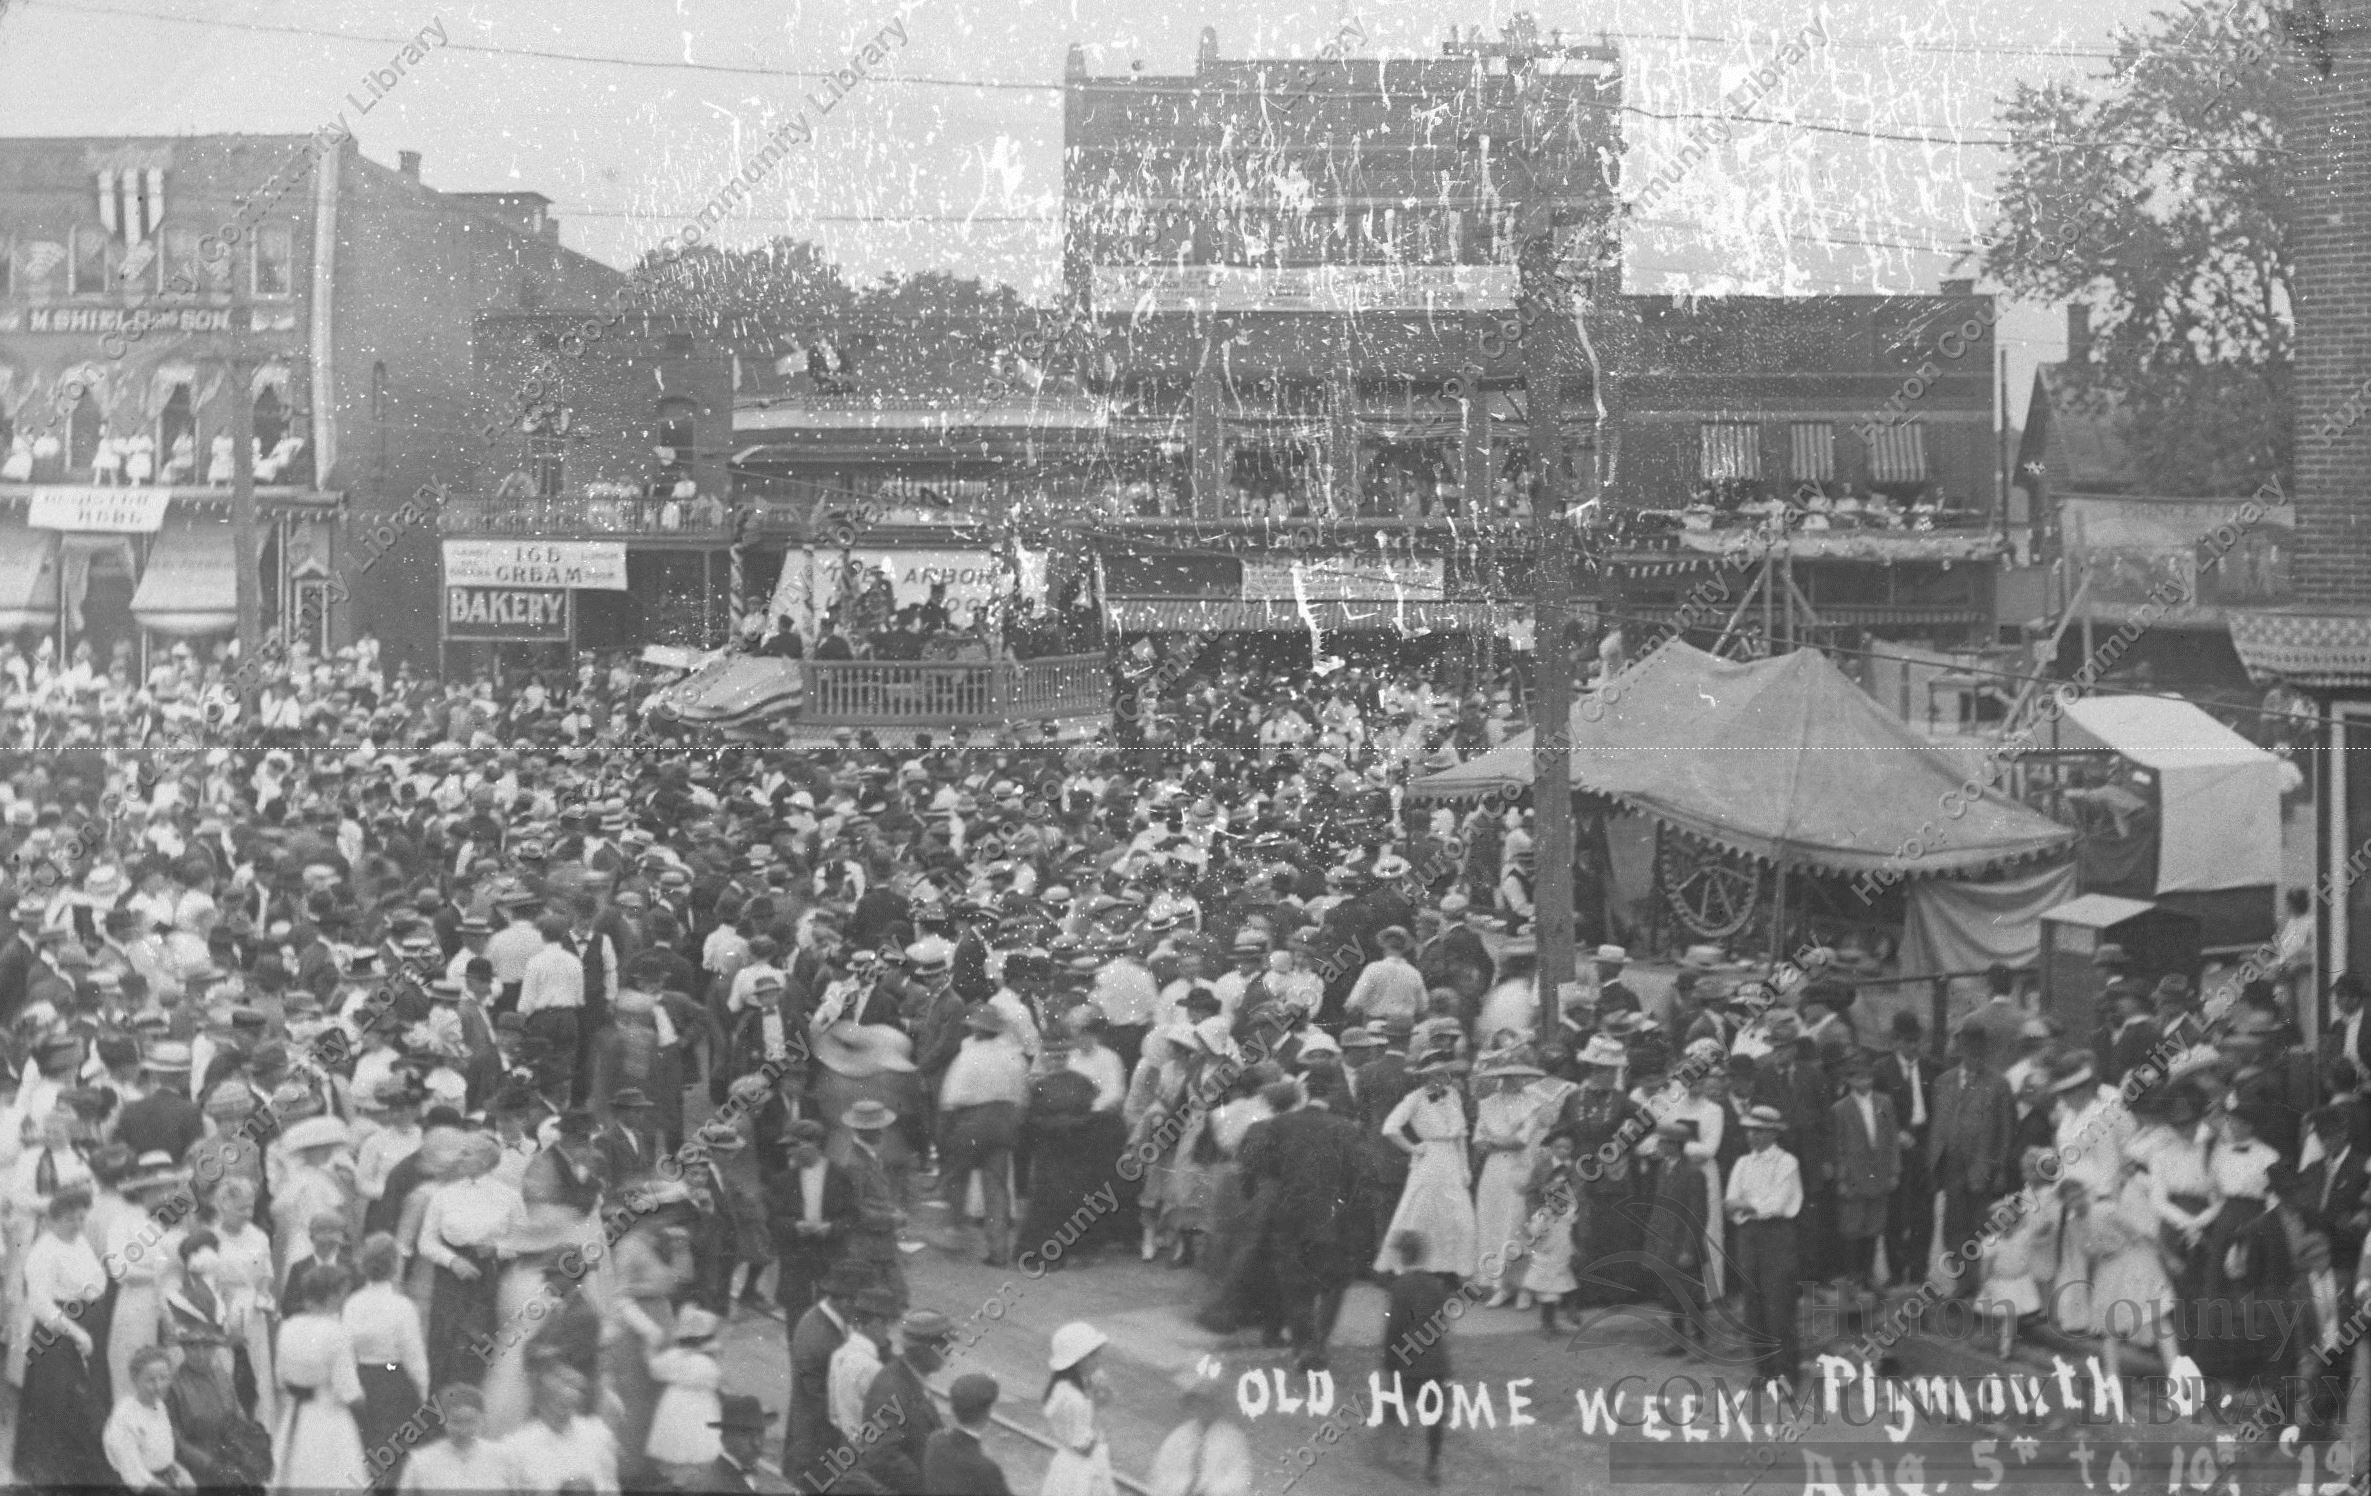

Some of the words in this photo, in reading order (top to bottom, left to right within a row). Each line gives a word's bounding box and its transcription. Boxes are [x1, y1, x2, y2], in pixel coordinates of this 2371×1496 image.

[181, 309, 231, 330] SON
[496, 566, 583, 584] CREAM
[826, 565, 879, 584] TE
[450, 587, 563, 624] BAKERY
